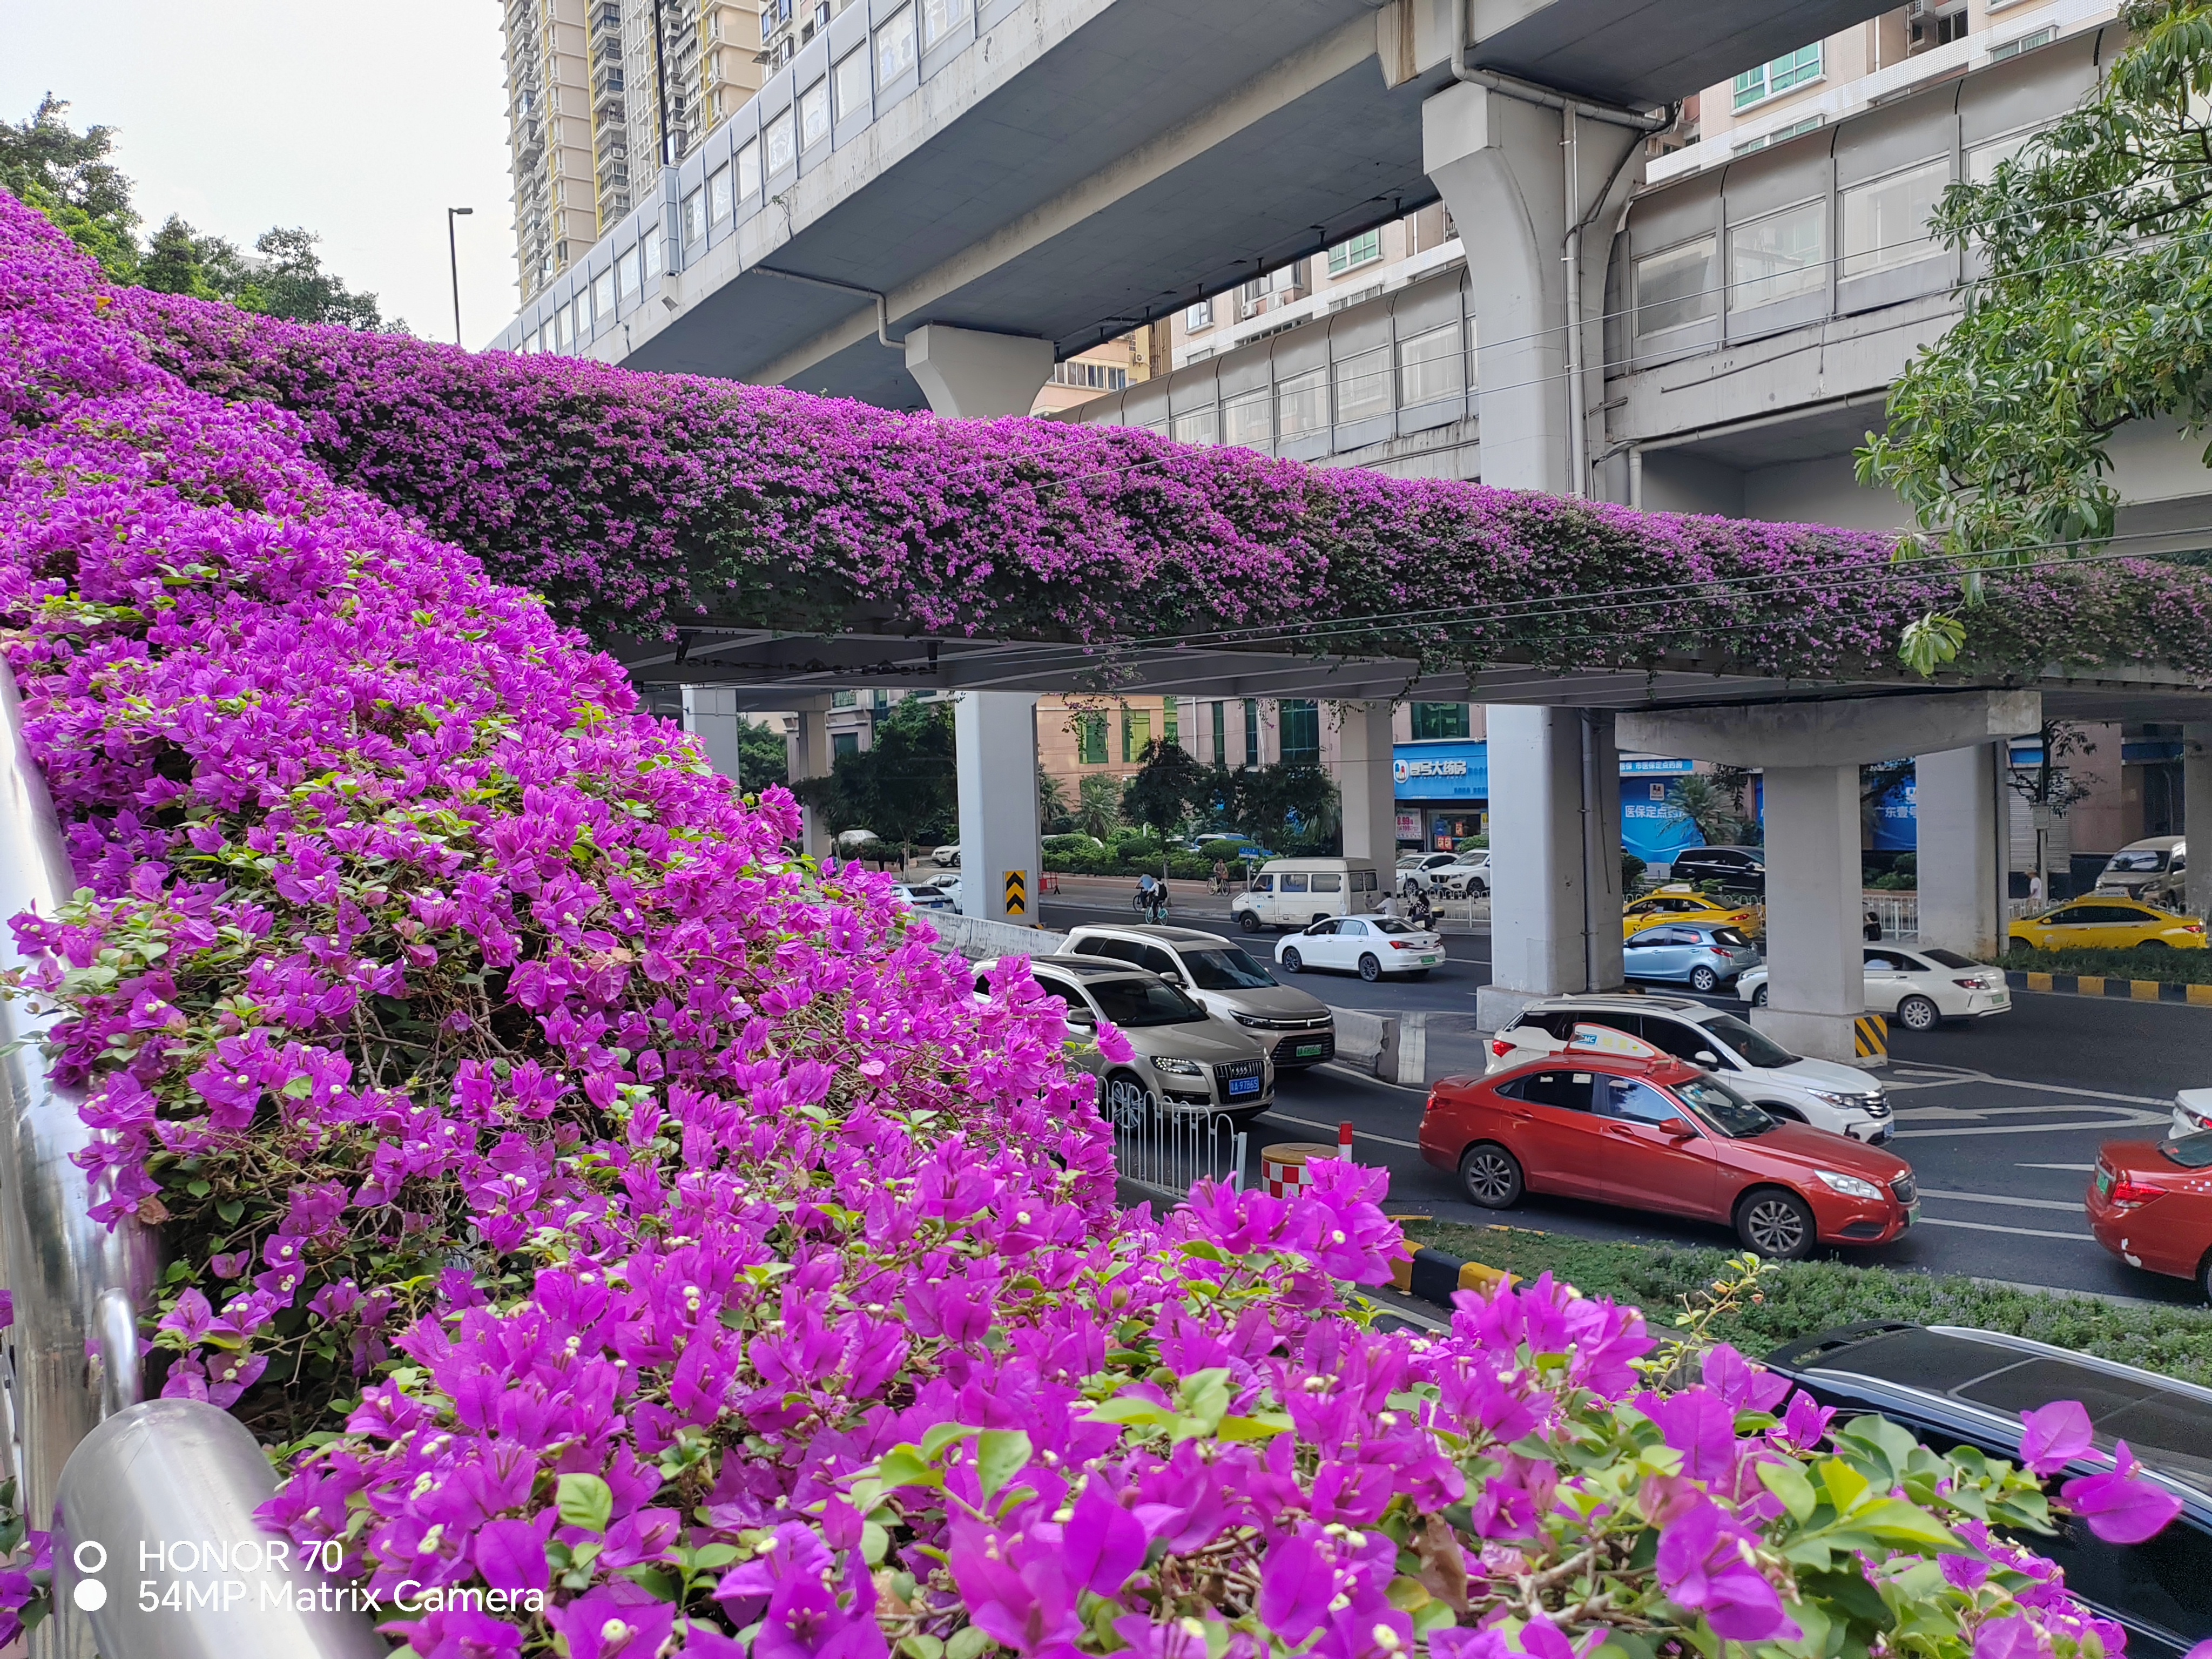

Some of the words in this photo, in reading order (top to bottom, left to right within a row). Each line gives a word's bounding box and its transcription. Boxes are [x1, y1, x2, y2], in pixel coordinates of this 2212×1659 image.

[1410, 760, 1467, 776] 壹号大药房
